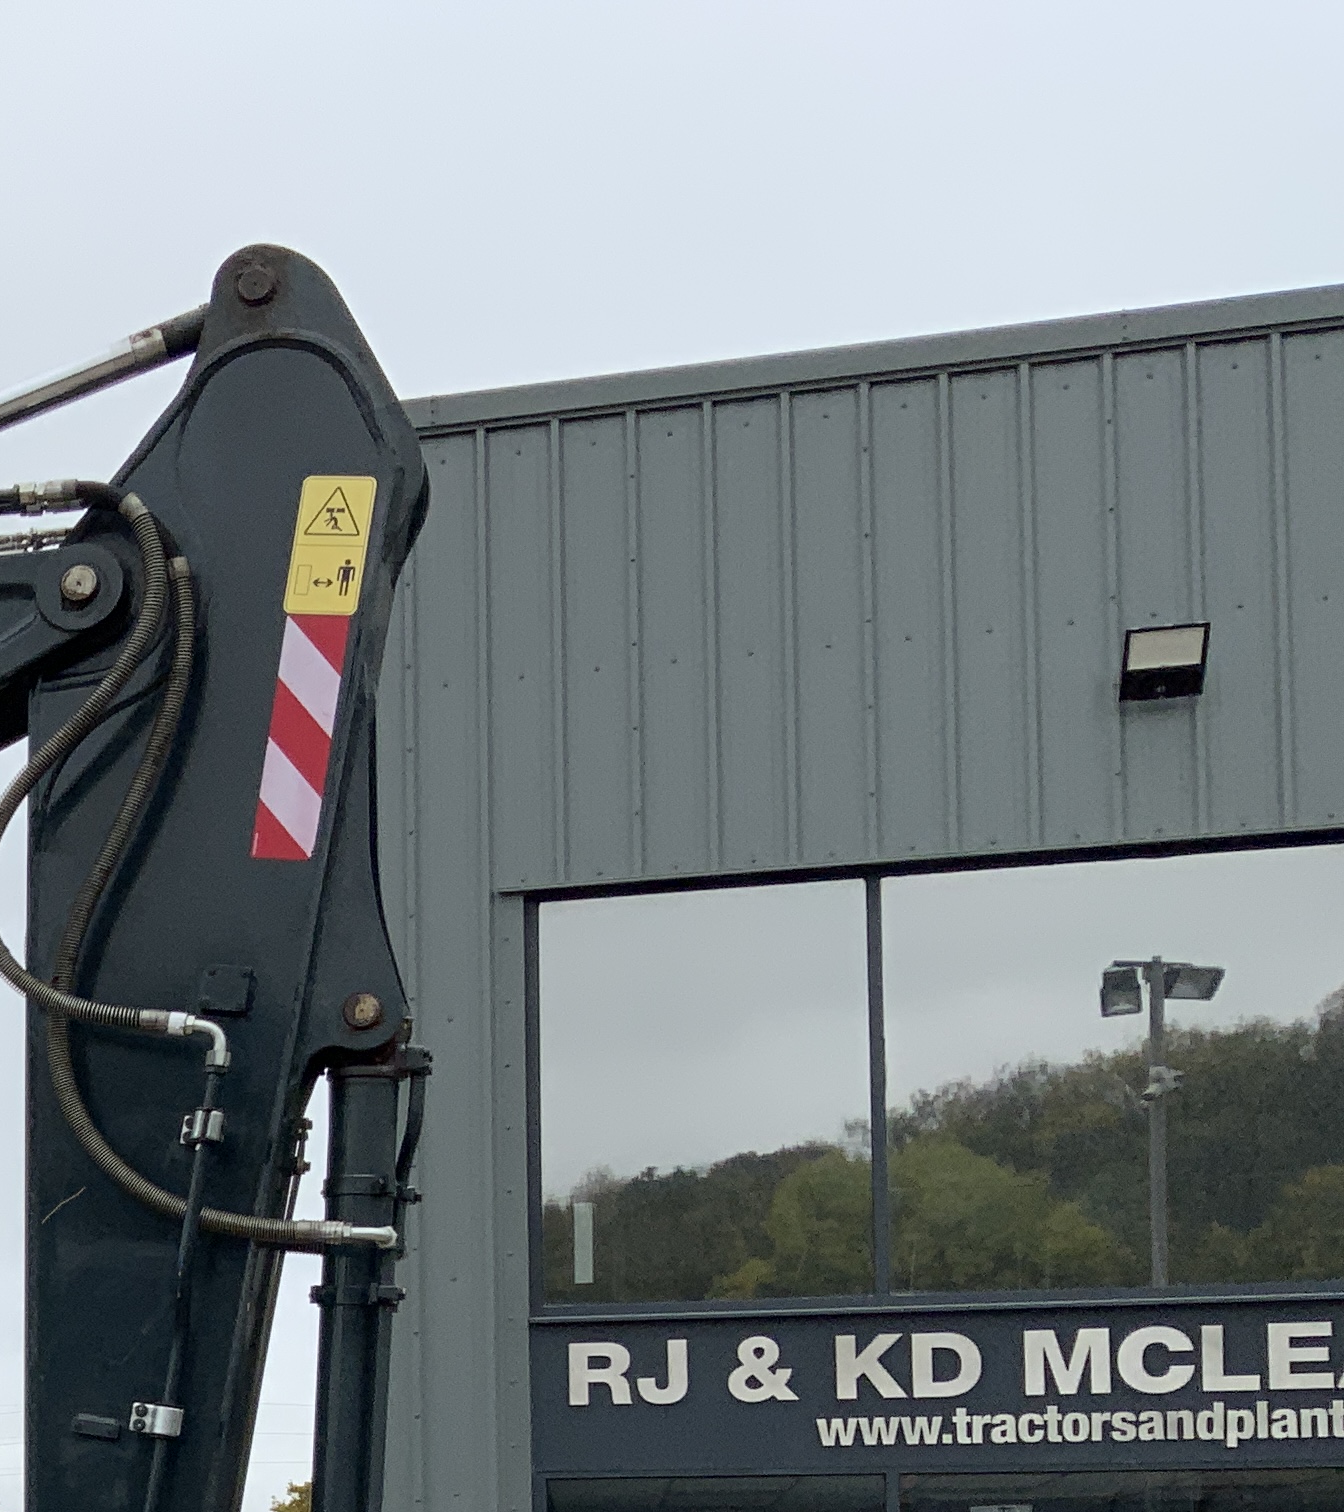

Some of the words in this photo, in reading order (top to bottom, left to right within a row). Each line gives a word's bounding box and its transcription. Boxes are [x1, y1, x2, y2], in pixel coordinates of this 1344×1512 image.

[568, 1339, 688, 1406] RJ
[728, 1336, 800, 1402] &
[835, 1332, 982, 1399] KD
[1023, 1321, 1344, 1396] MCLE
[816, 1400, 1344, 1448] www.tractorsandplant
